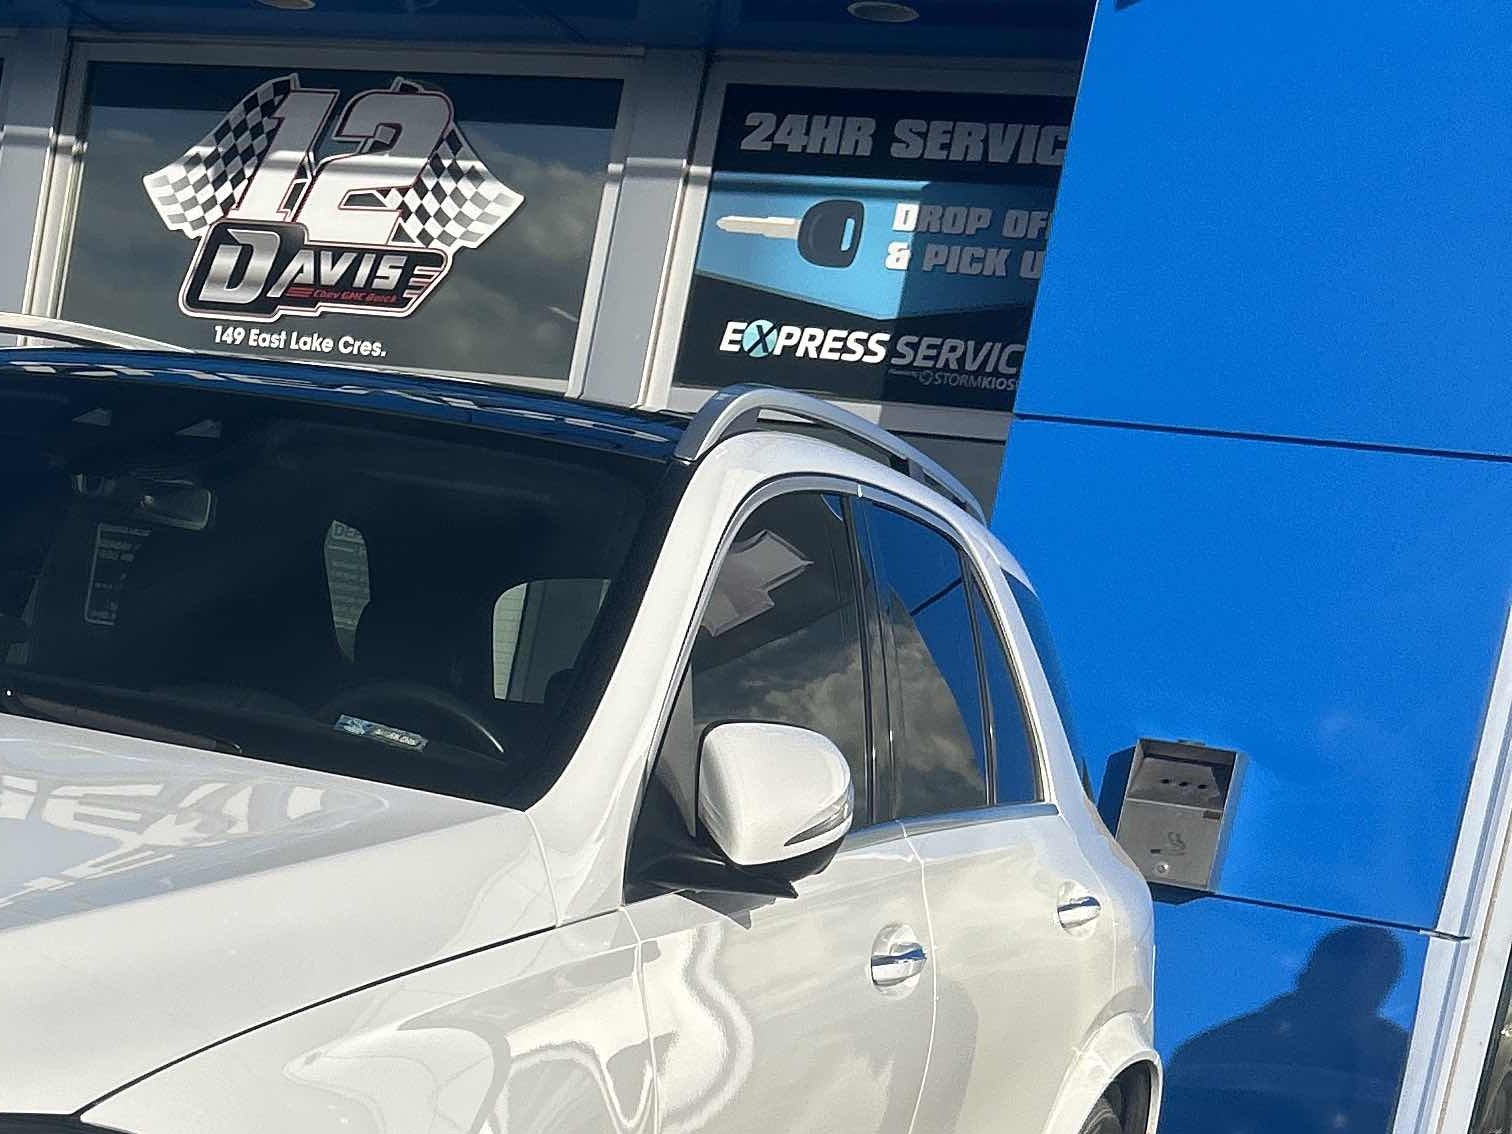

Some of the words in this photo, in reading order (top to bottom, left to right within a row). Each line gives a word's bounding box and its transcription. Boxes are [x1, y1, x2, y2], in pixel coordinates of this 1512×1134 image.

[740, 112, 876, 156] 24HR
[890, 118, 1070, 165] SERVIC
[232, 89, 454, 246] 12
[892, 201, 992, 236] DROP
[1002, 209, 1050, 239] OF
[198, 229, 406, 306] DAVIS
[885, 242, 912, 271] &
[922, 243, 1011, 277] PICK
[1020, 250, 1044, 279] U
[214, 325, 246, 345] 149
[248, 328, 287, 349] East
[290, 331, 334, 353] Lake
[338, 335, 388, 358] Cres.
[719, 319, 890, 363] EXPRESS
[890, 335, 1025, 374] SERVIC
[933, 372, 1018, 391] STORMKIOS
